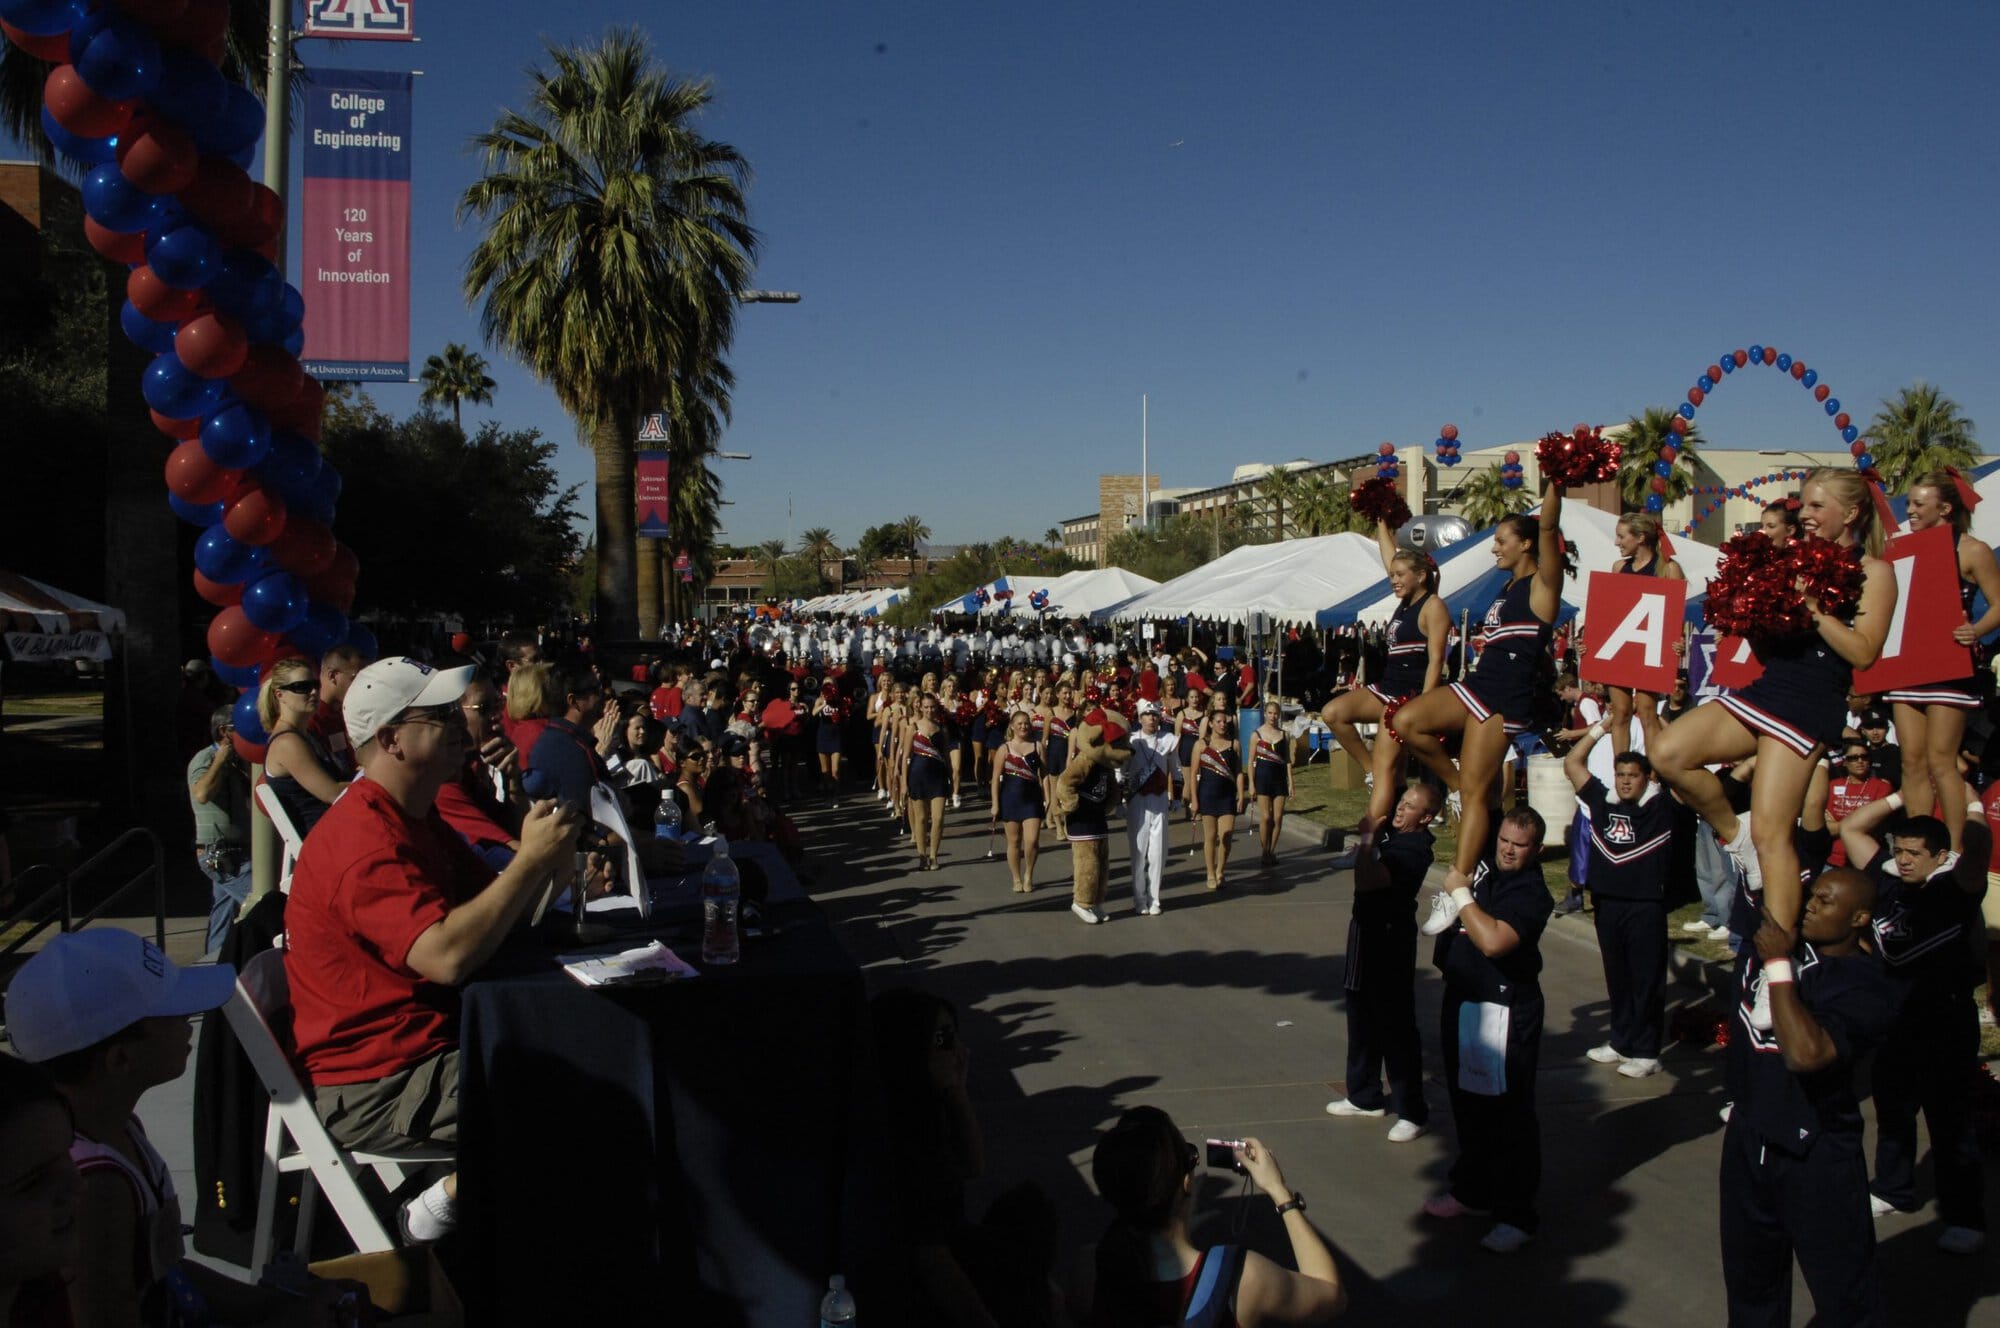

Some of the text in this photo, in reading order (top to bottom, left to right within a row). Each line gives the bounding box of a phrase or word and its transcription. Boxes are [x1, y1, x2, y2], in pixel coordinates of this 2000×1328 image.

[331, 93, 385, 114] College
[350, 113, 366, 128] of
[313, 129, 401, 152] Engineering
[343, 208, 367, 222] 120
[335, 227, 373, 242] Years
[347, 248, 362, 262] of
[318, 267, 390, 283] Innovation
[319, 365, 359, 375] UNIVERSITY
[360, 367, 368, 375] OF
[370, 366, 405, 376] ARIZONA
[1594, 592, 1666, 668] A
[1604, 813, 1635, 844] A
